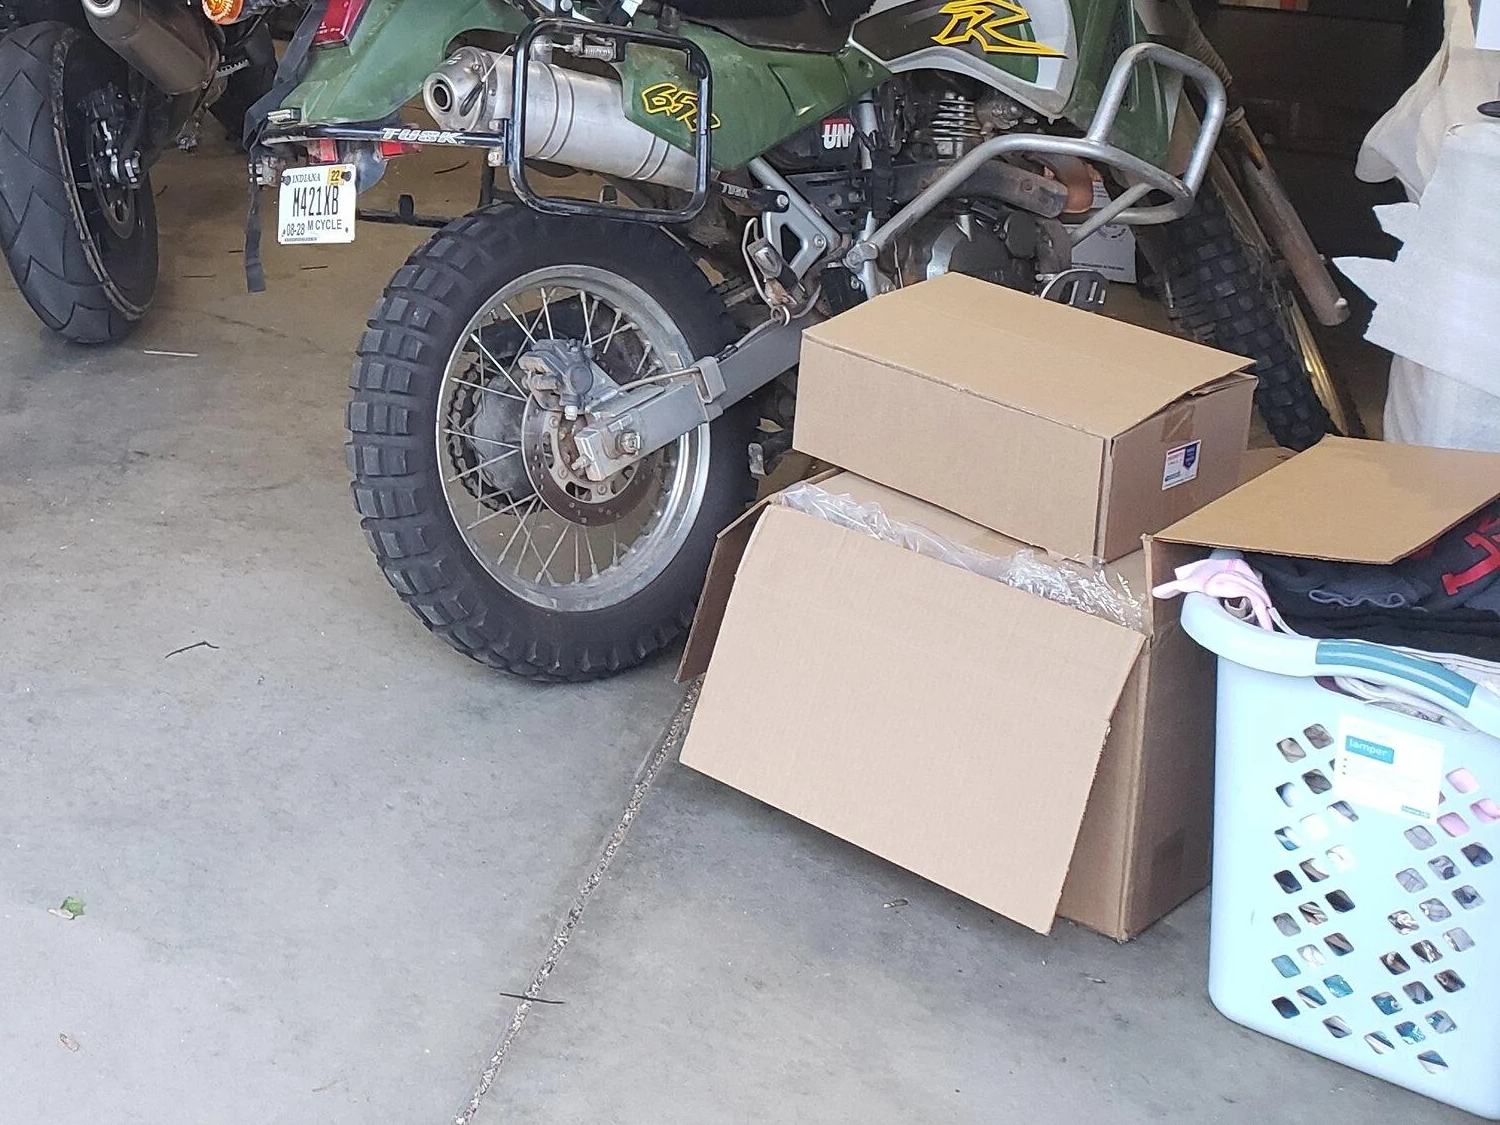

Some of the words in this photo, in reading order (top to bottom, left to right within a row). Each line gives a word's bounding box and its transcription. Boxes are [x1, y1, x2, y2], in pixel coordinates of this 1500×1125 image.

[382, 127, 464, 145] TUSK
[292, 172, 321, 183] INDIANA
[330, 169, 340, 182] 22
[307, 220, 314, 230] M
[315, 219, 342, 230] CYCLE
